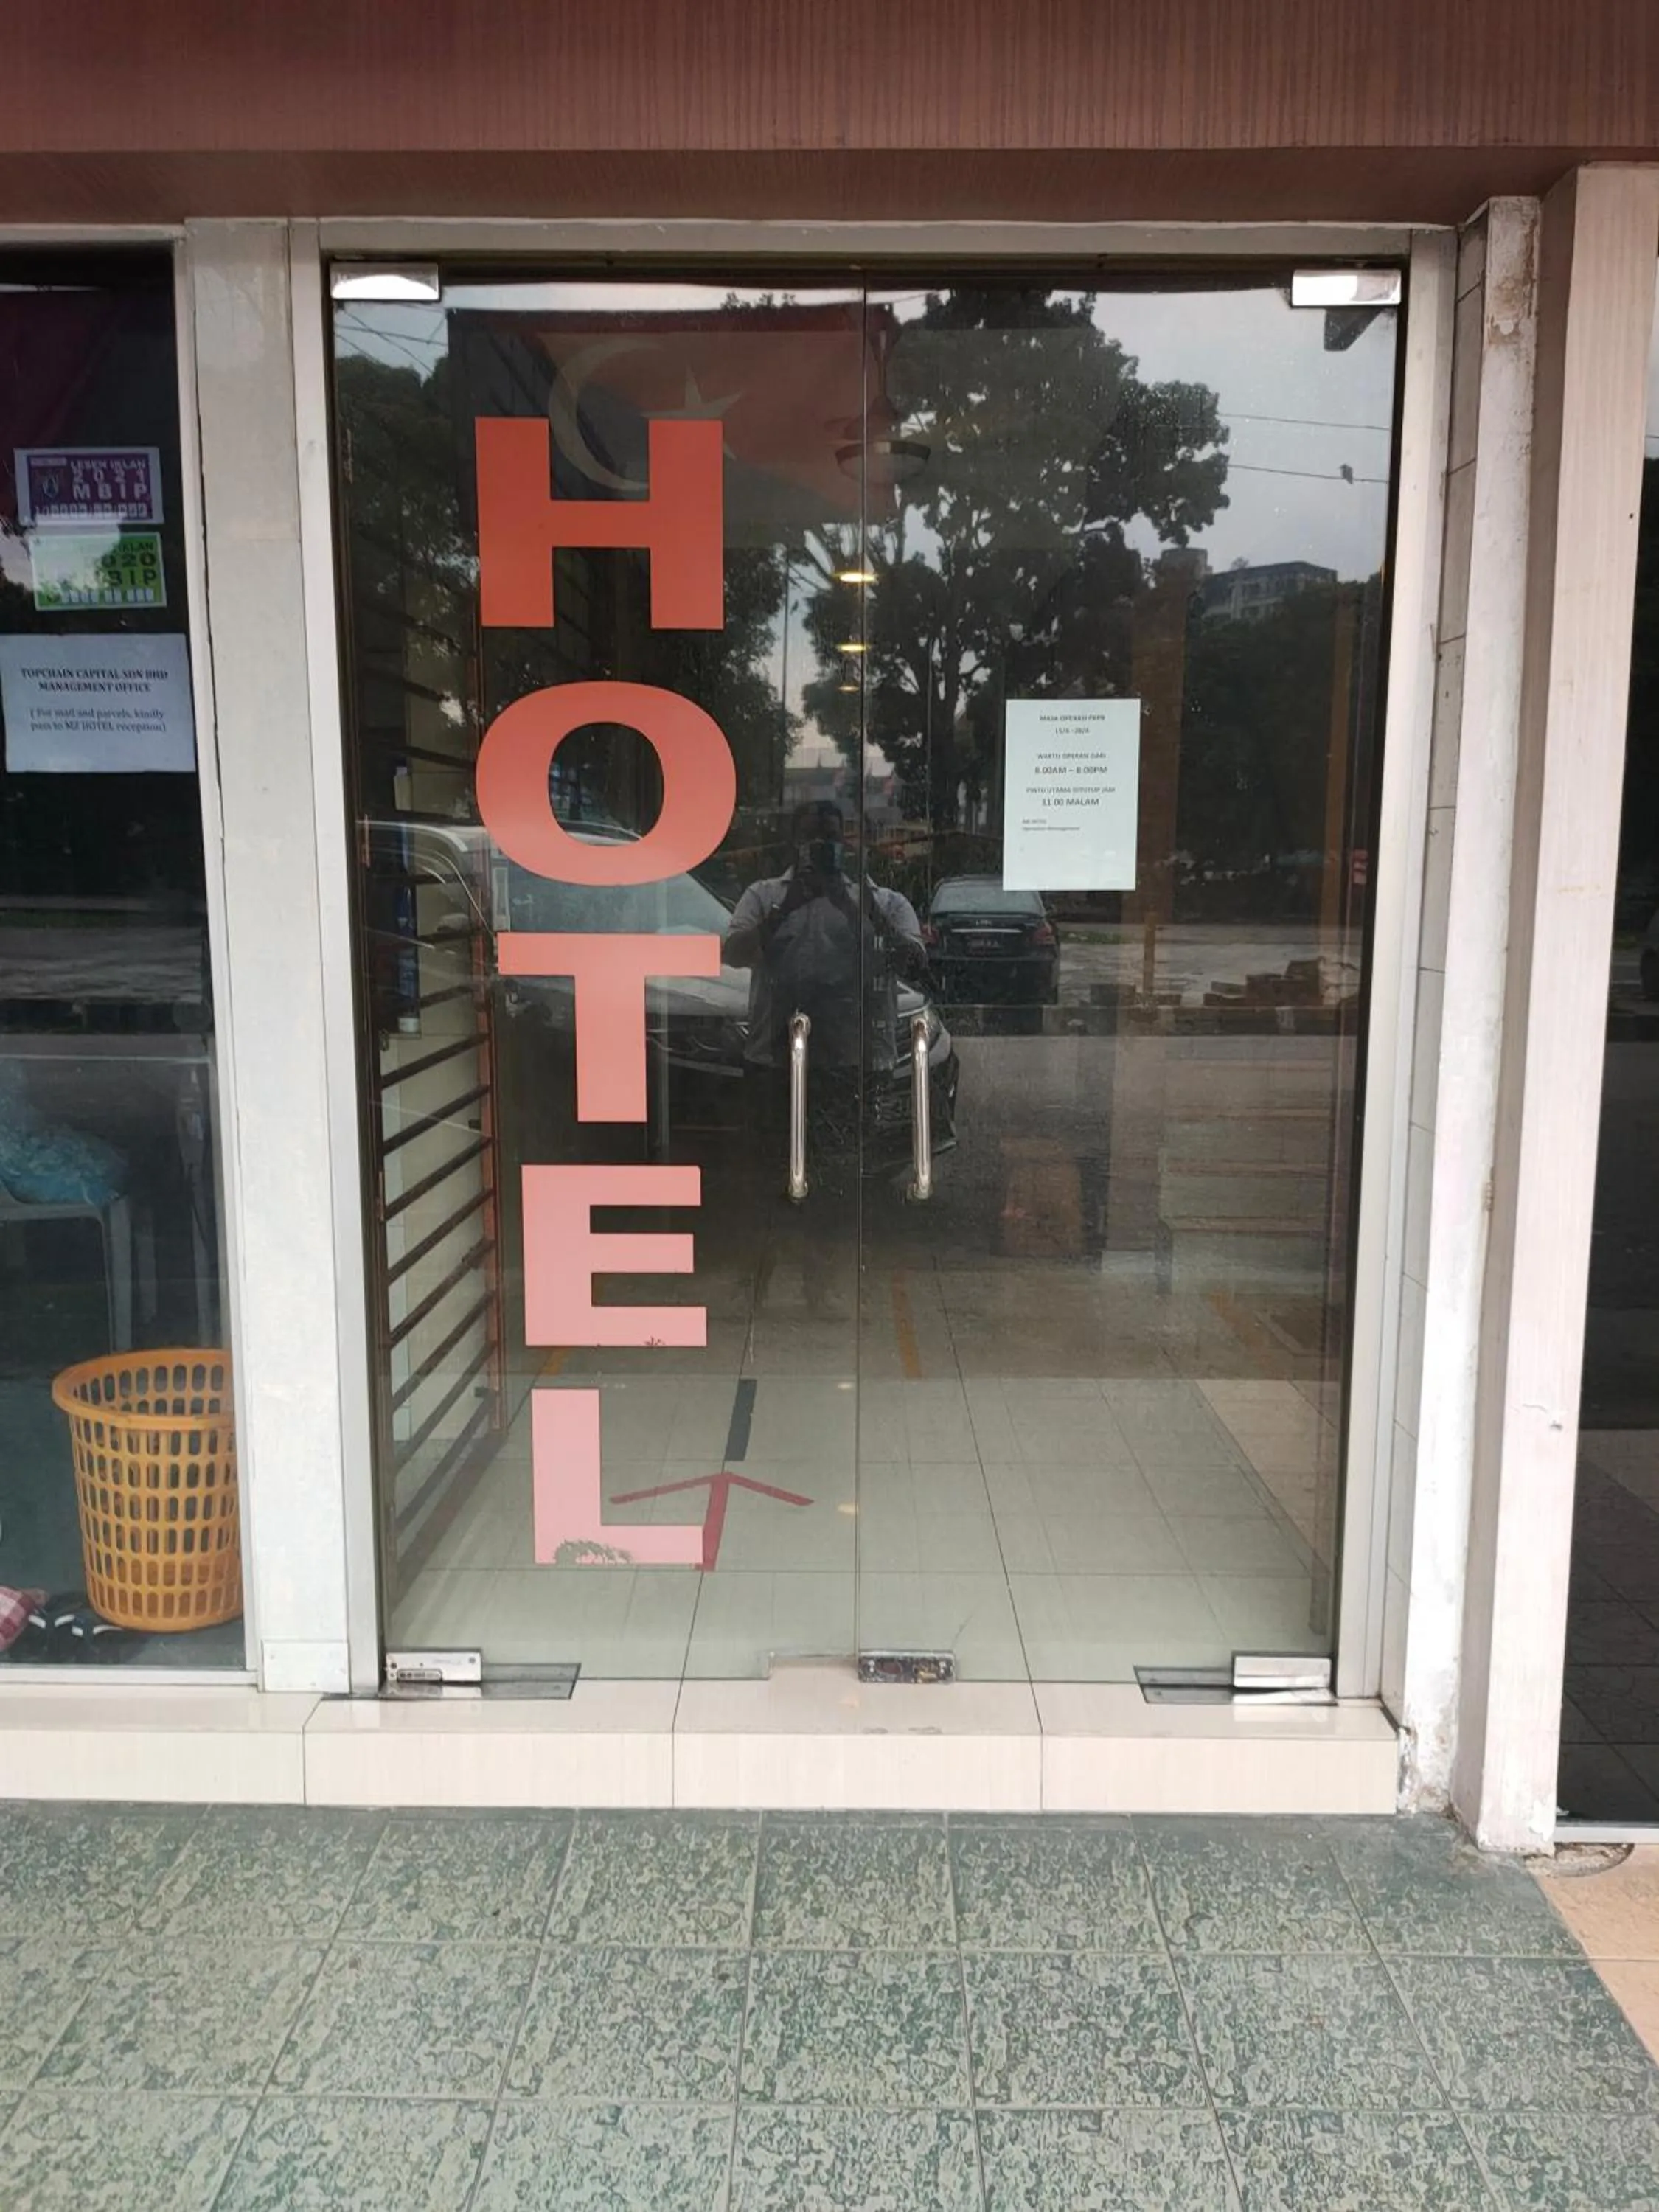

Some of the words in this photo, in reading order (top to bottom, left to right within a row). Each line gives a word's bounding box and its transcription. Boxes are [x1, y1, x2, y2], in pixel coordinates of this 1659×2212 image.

[73, 483, 147, 501] MBIP
[75, 668, 119, 680] CAPITAL
[122, 669, 143, 680] SDN
[145, 669, 169, 680] BHD
[38, 681, 114, 692] MANAGEMENT
[114, 682, 152, 693] OFFICE
[77, 707, 94, 717] and
[133, 708, 164, 719] kindly
[81, 720, 115, 731] HOTEL
[1065, 798, 1099, 806] MALAM
[476, 417, 737, 1564] HOTEL
